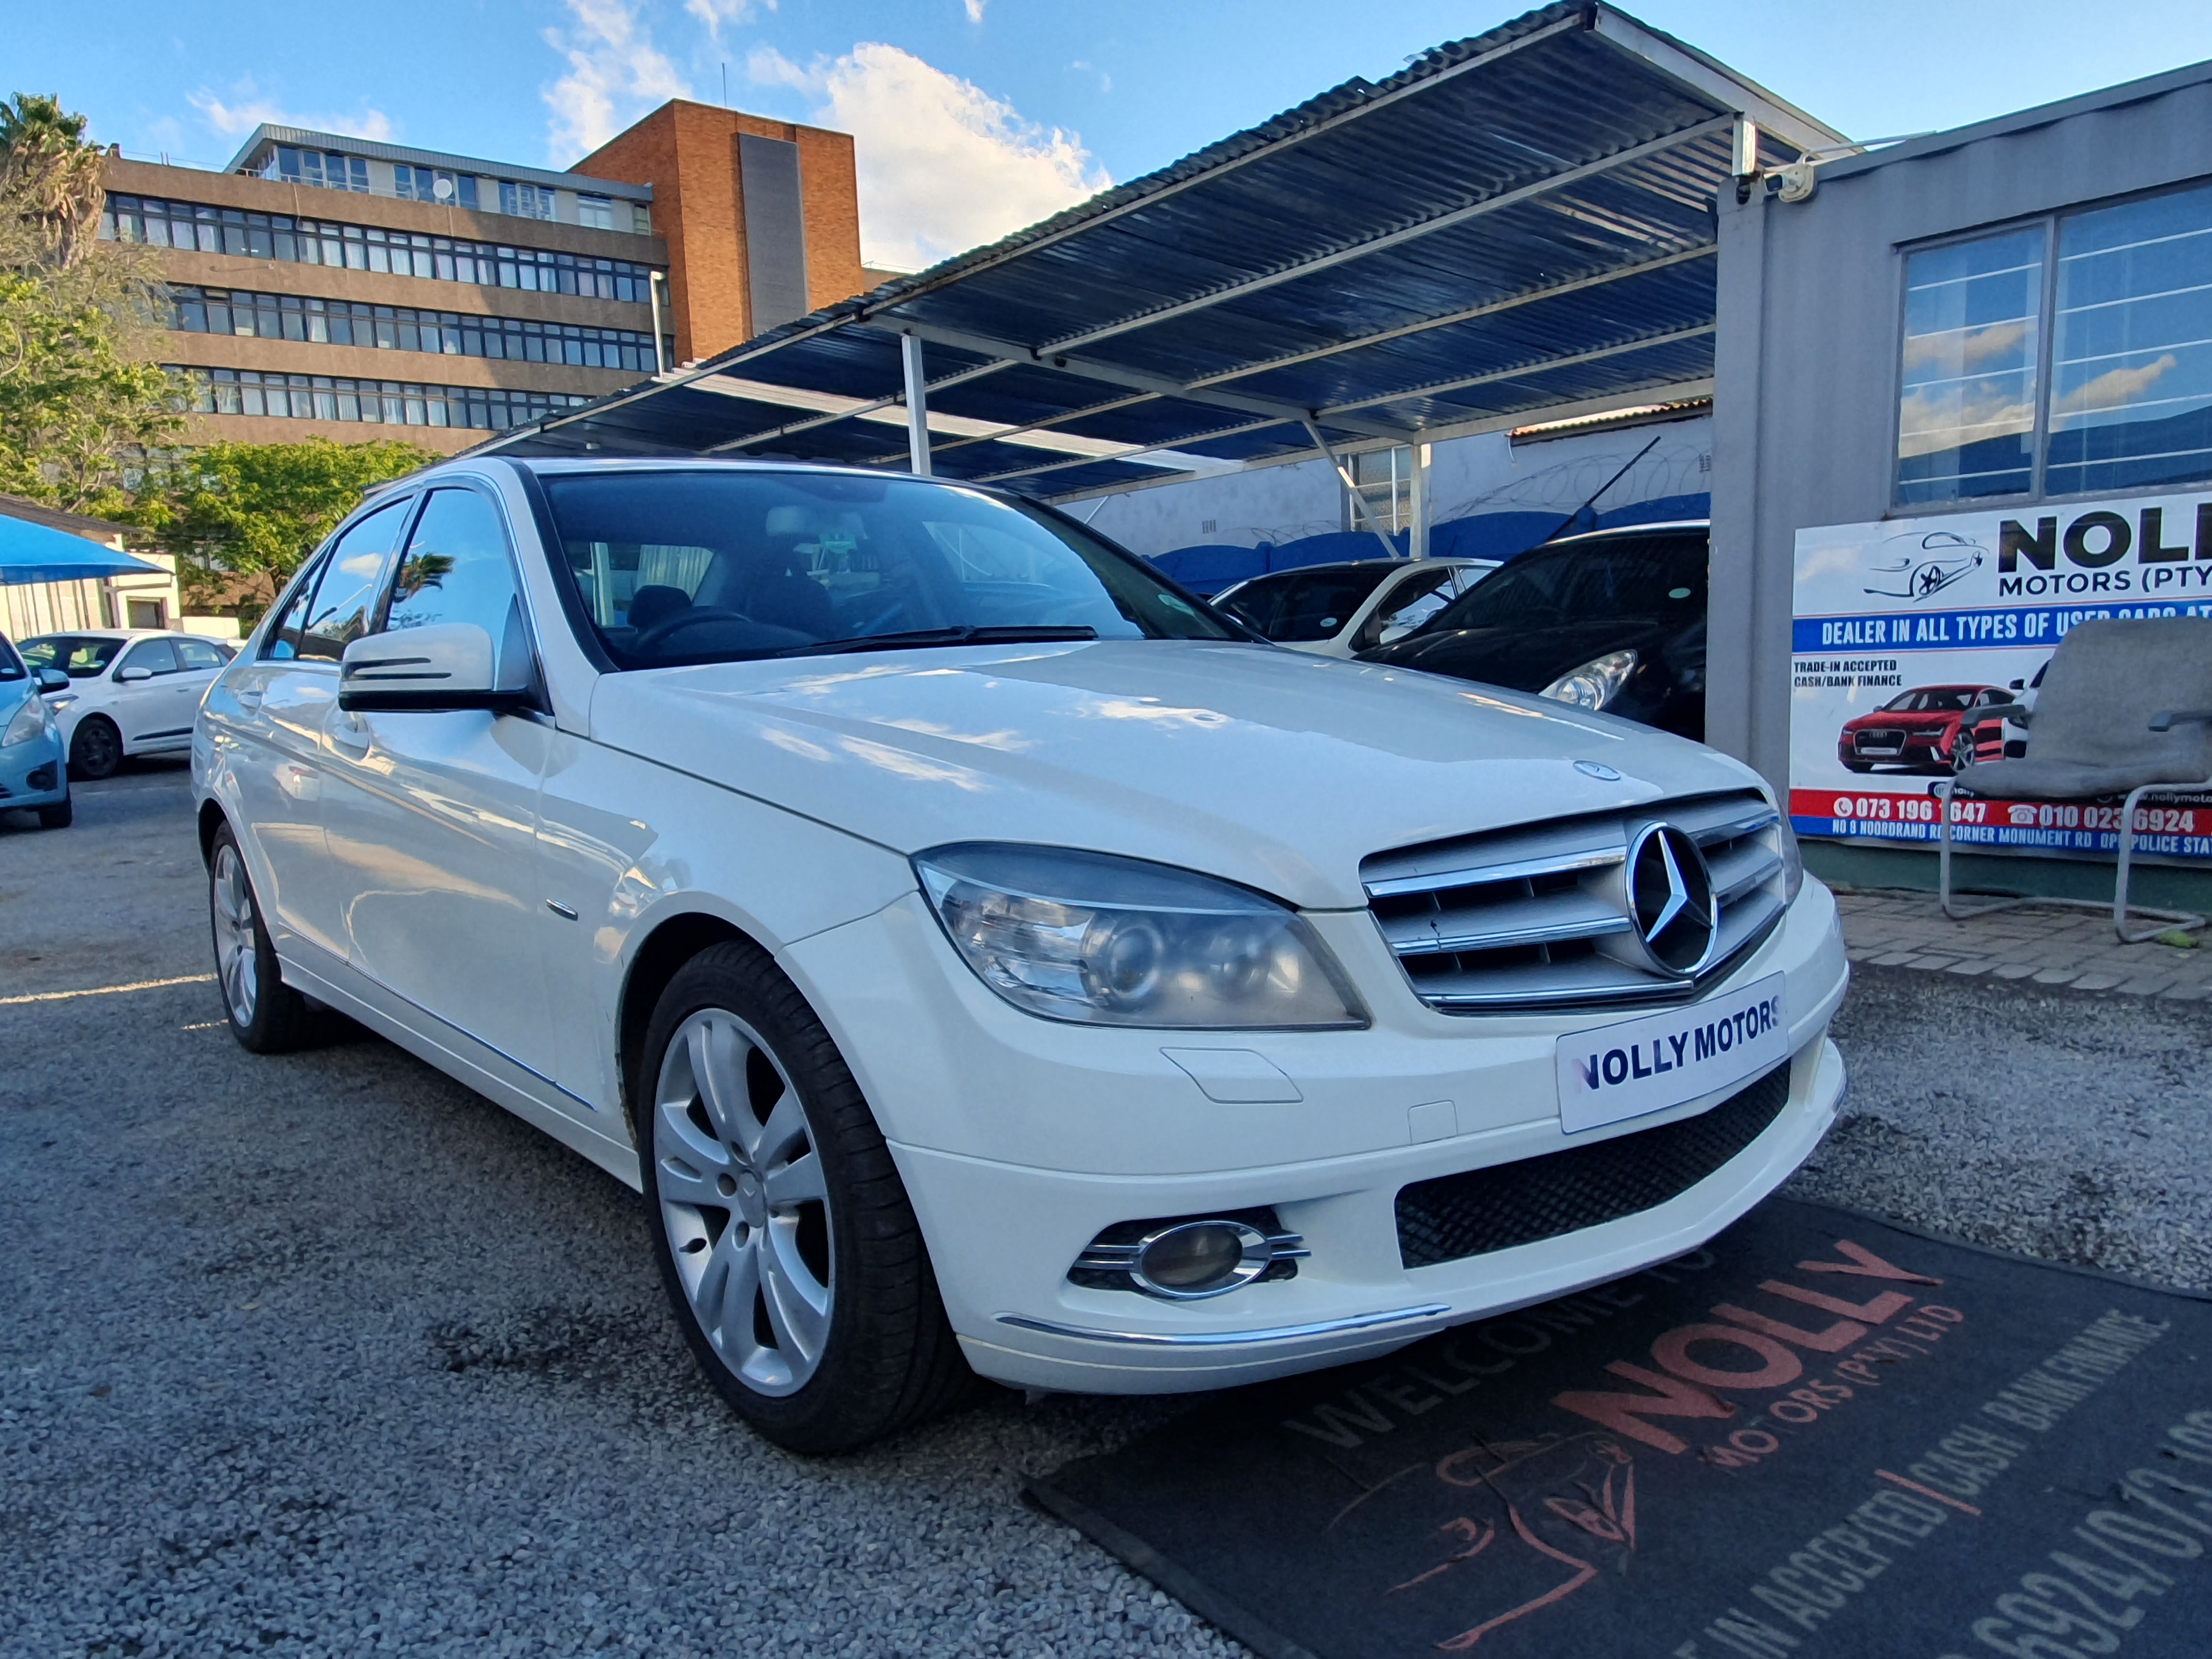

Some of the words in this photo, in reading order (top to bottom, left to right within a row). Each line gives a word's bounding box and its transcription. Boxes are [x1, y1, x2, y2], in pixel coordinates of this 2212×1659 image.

[1999, 570, 2131, 597] MOTORS
[1822, 618, 1886, 645] DEALER
[1892, 618, 1910, 642] IN
[1916, 616, 1949, 641] ALL
[1956, 613, 2017, 640] TYPES
[2024, 612, 2050, 637] OF
[1794, 661, 1840, 673] TRADE-IN
[1843, 660, 1897, 672] ACCEPTED
[1794, 675, 1855, 687] CASH/BANK
[1857, 674, 1902, 687] FINANCE
[1856, 798, 1890, 818] 073
[1897, 800, 1932, 820] 196
[1938, 800, 1986, 823] 647
[2117, 792, 2212, 804] w.nollymoto
[2039, 805, 2079, 827] 010
[2083, 806, 2123, 830] 023
[2133, 808, 2194, 833] 6924
[1832, 819, 1847, 834] NO
[1860, 820, 1926, 839] NOORDRAND
[1949, 825, 1995, 842] CORNER
[1998, 827, 2072, 847] MONUMENT
[2075, 831, 2092, 848] RD
[2130, 834, 2180, 853] POLICE
[2184, 836, 2212, 854] STA
[1572, 1031, 1689, 1094] NOLLY
[1694, 995, 1779, 1063] MOTORS
[1552, 1238, 1945, 1455] NOLLY
[1281, 1282, 1644, 1449] WELCOME
[1698, 1377, 1854, 1468] MOORS
[1895, 1305, 1964, 1341] LTD
[1749, 1490, 1948, 1631] ACCEPTED
[2043, 1309, 2171, 1384] FINANCE
